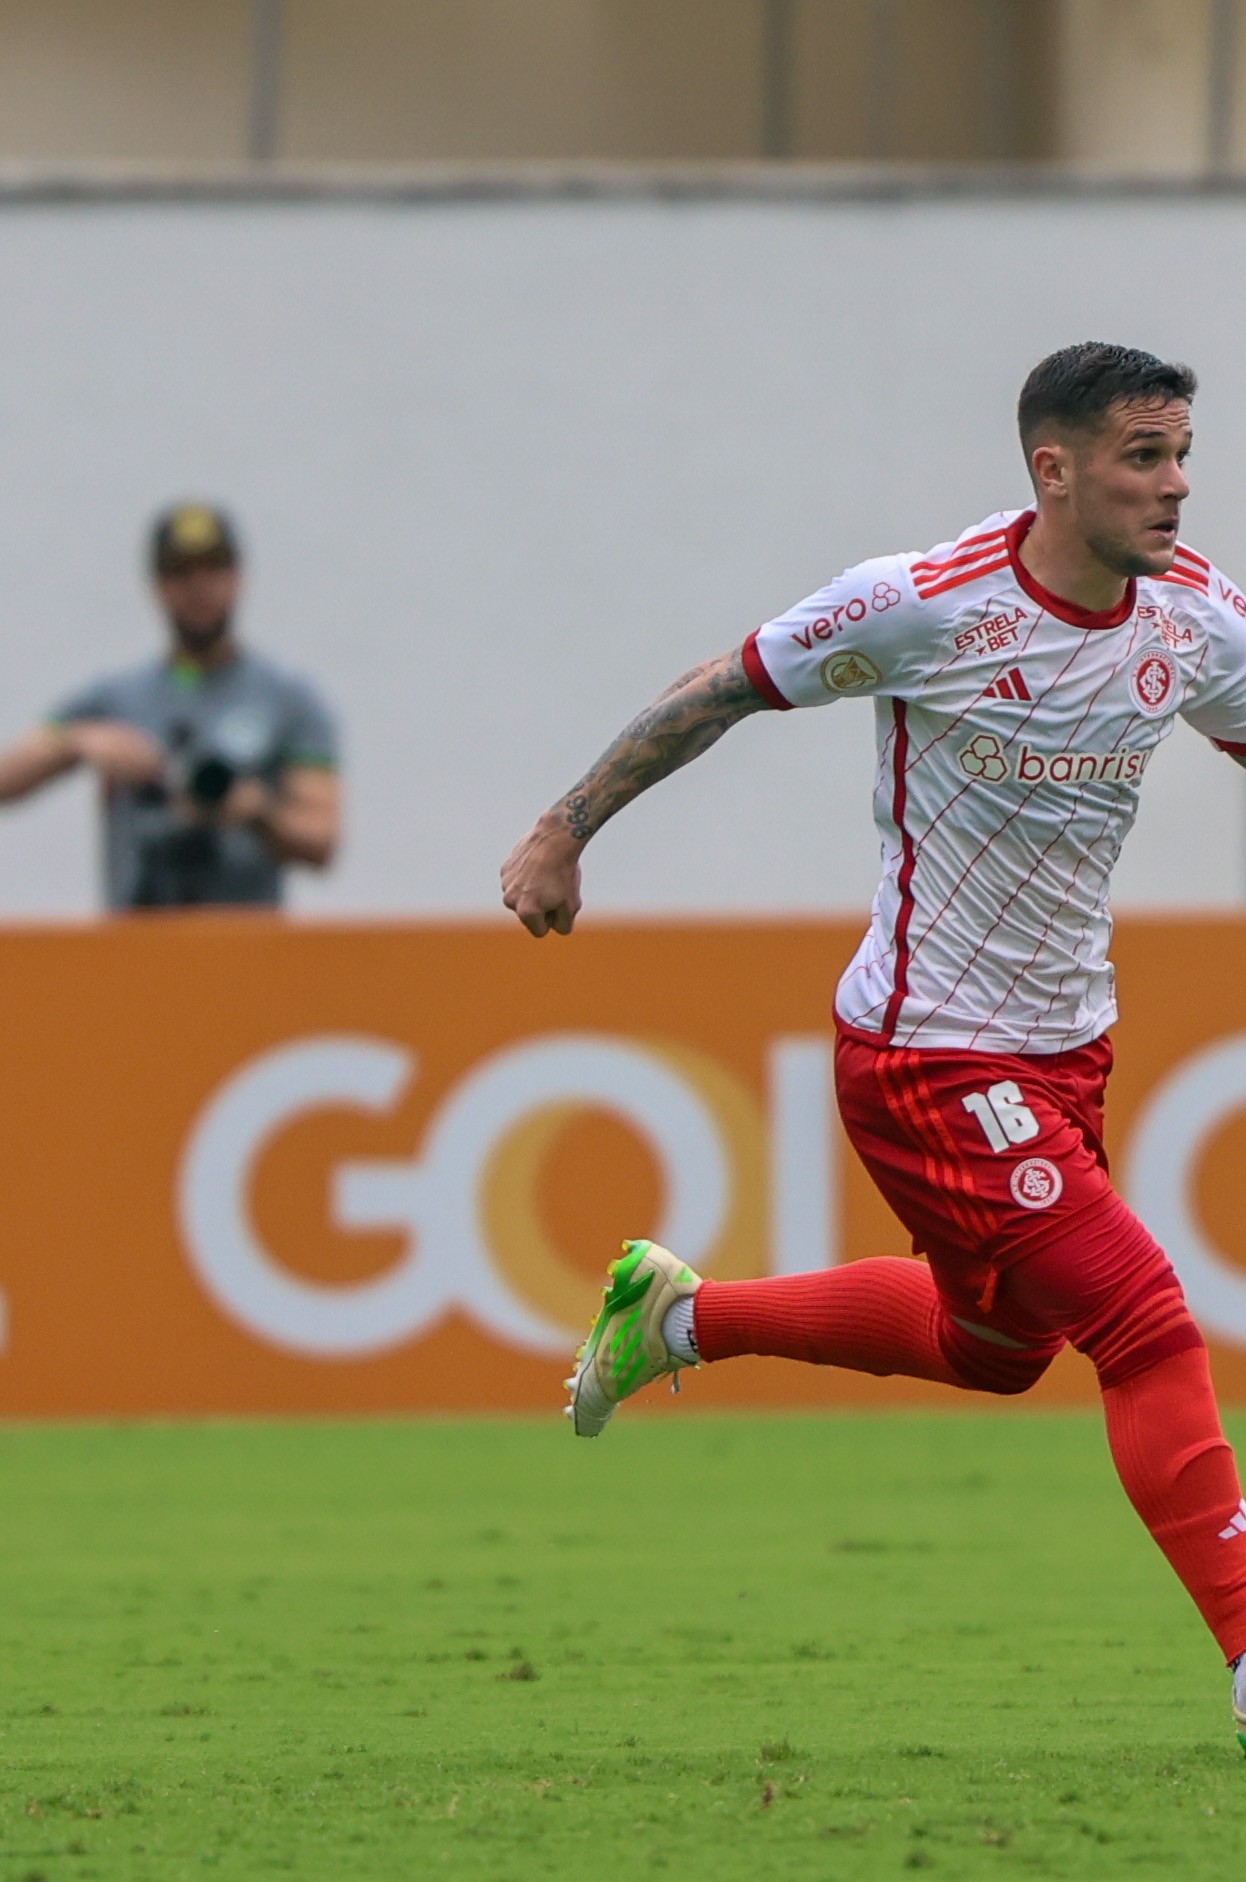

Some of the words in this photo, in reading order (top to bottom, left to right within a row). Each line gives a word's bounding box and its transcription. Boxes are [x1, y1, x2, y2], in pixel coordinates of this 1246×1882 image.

[791, 598, 867, 650] vero
[954, 606, 1028, 651] ESTRELA
[986, 626, 1019, 652] BET
[961, 1079, 1040, 1154] 16
